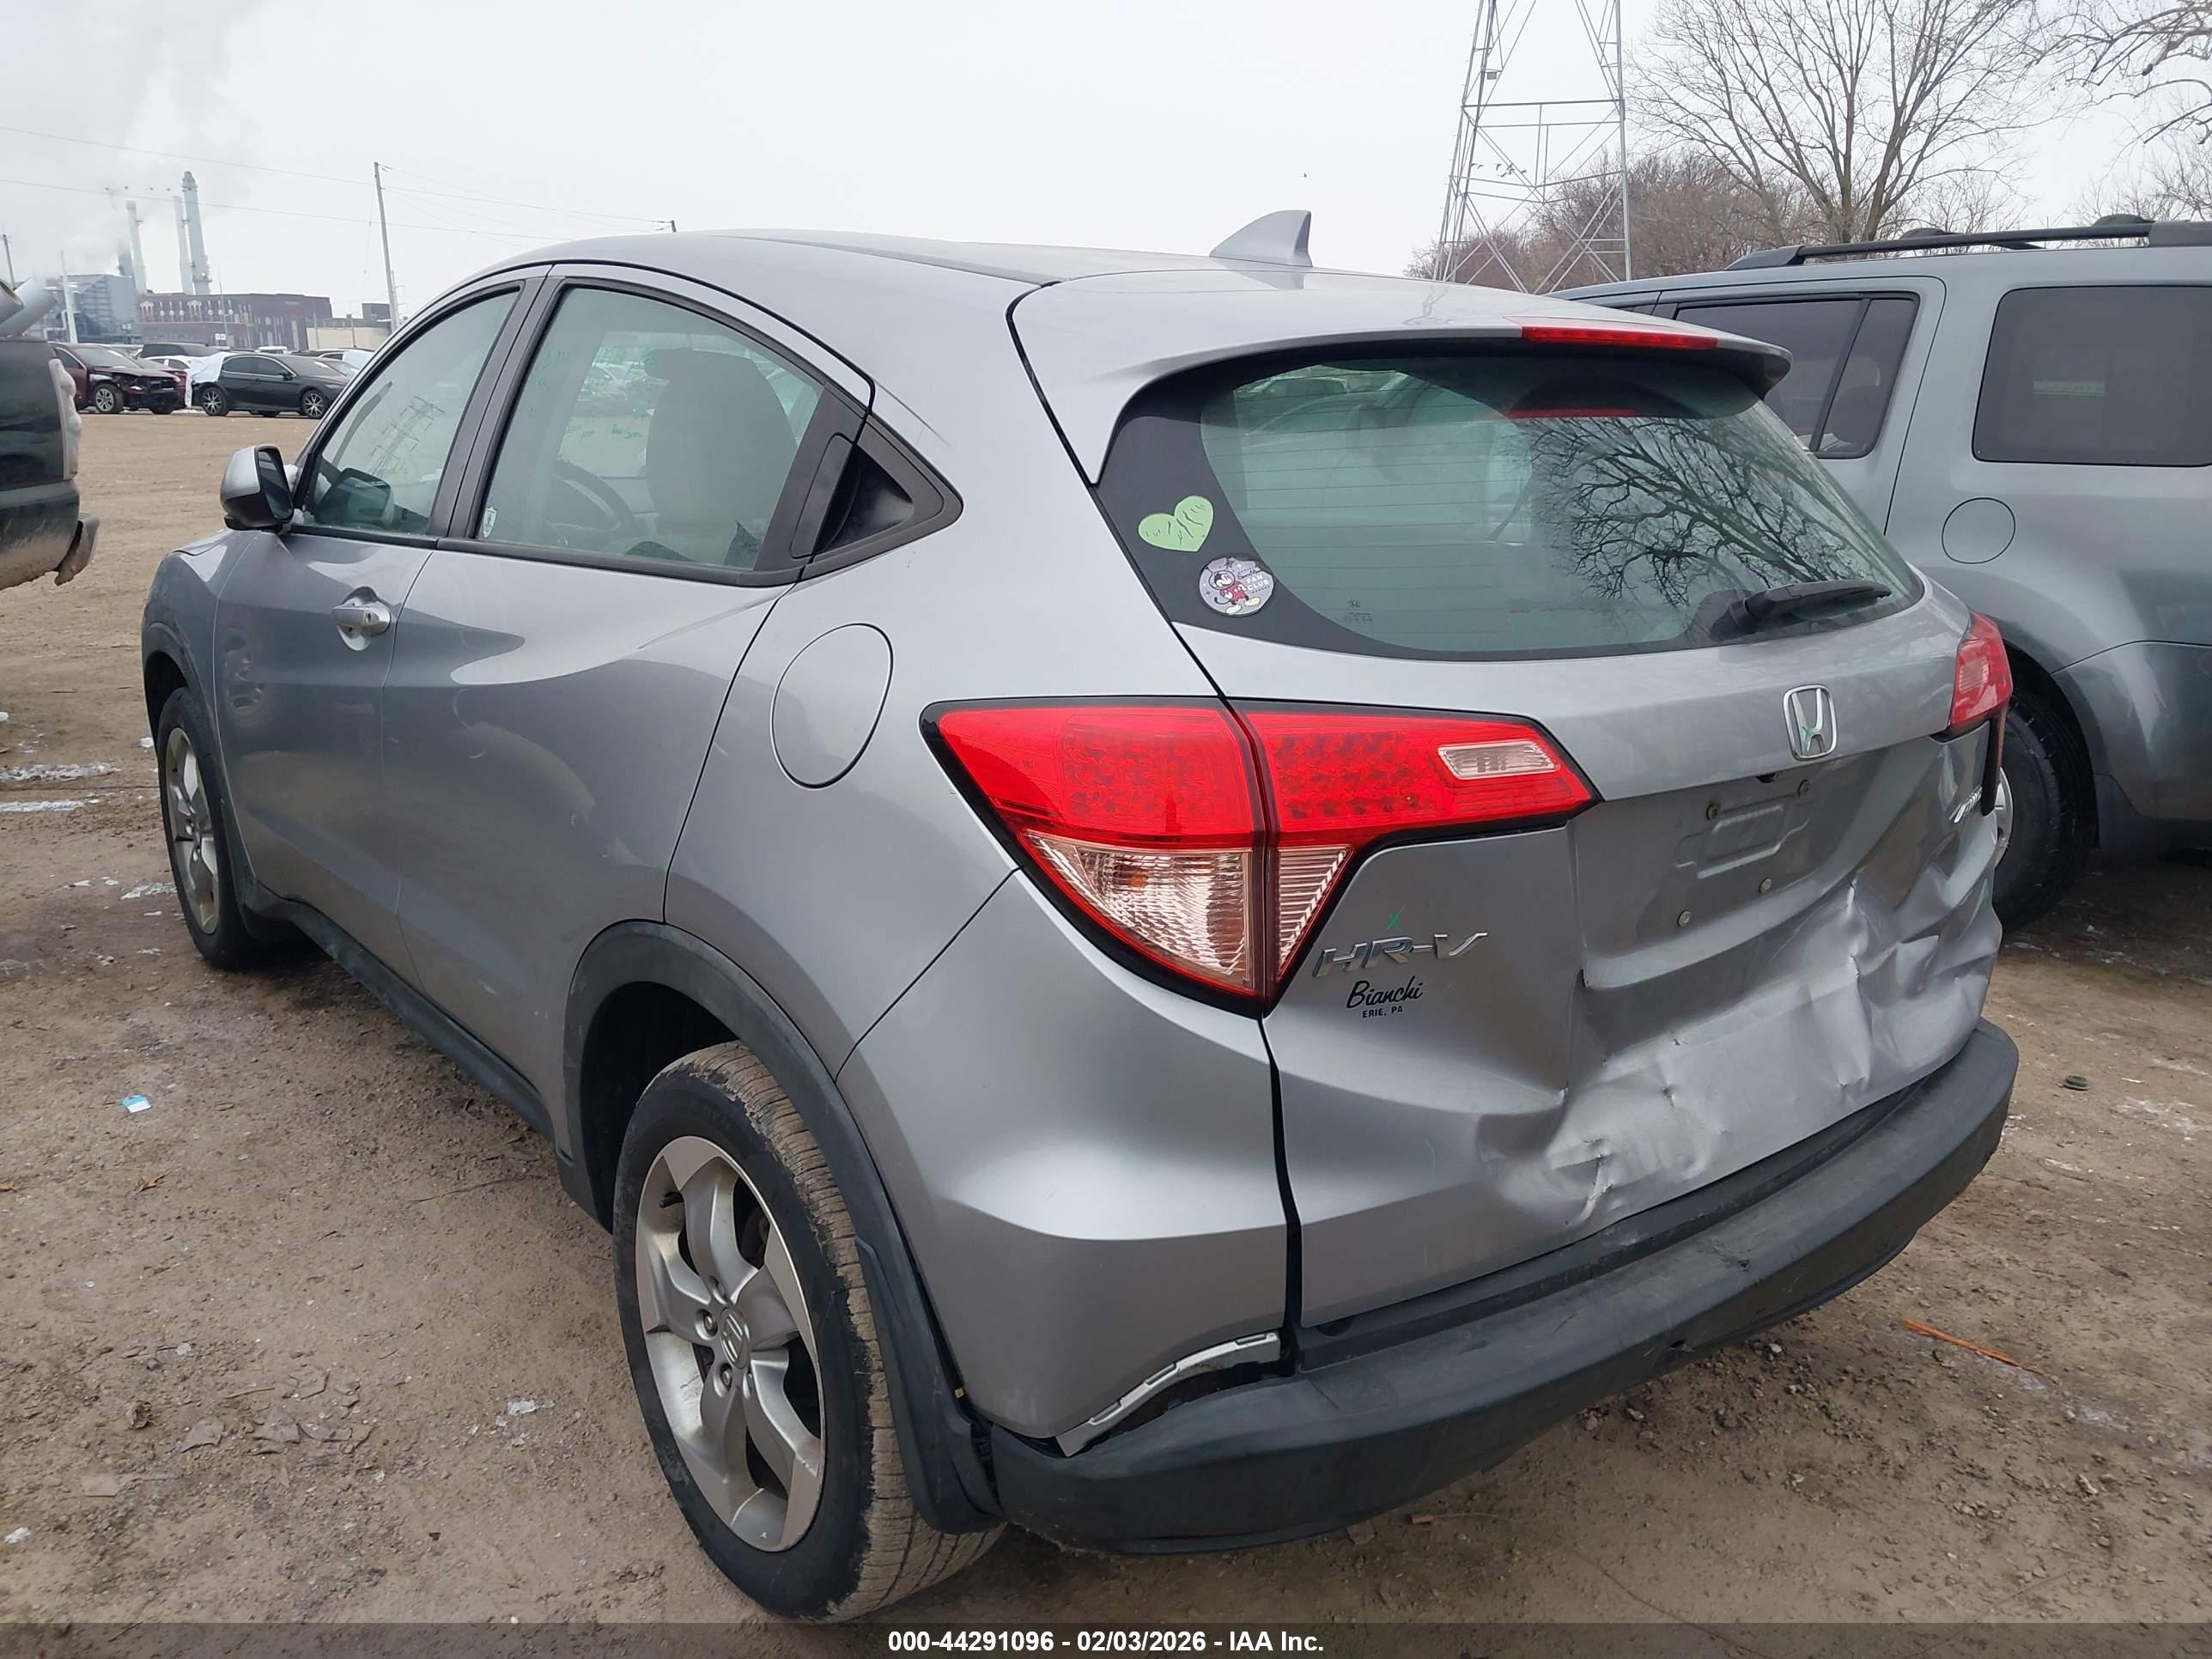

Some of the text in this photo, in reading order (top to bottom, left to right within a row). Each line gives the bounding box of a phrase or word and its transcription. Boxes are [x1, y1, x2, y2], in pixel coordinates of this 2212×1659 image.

[1312, 932, 1488, 977] HR-V
[1346, 975, 1424, 1009] Bianchi
[1362, 1006, 1403, 1018] ERIE, PA
